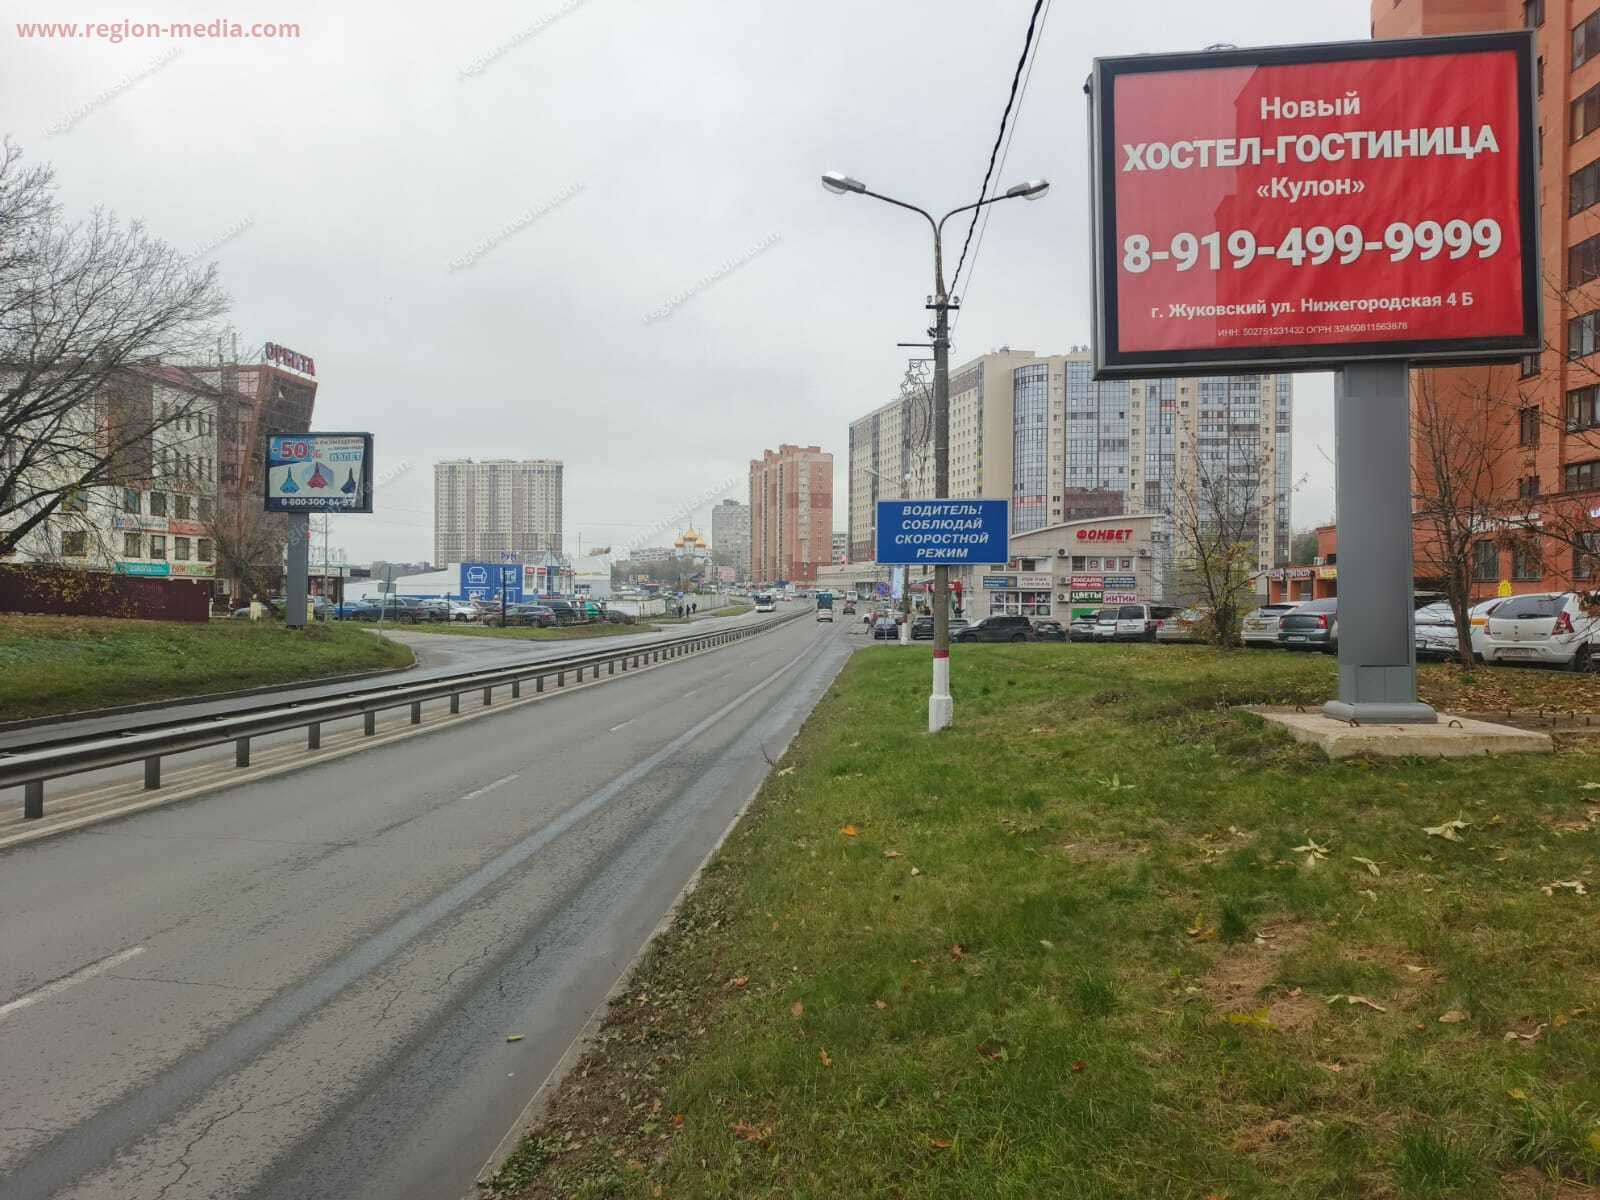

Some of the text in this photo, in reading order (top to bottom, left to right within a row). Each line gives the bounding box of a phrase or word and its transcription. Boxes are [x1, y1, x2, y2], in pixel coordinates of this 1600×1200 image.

[1260, 90, 1360, 120] Новый
[1122, 124, 1499, 172] ХОСТЕЛ-ГОСТИНИЦА
[1256, 176, 1365, 203] «Кулон»
[1123, 218, 1502, 273] 8-919-499-9999
[1151, 292, 1474, 319] г. Жуковский ул. Нижегородская 4 Б
[902, 505, 983, 517] ВОДИТЕЛЬ!
[902, 517, 983, 530] СОБЛЮДАЙ
[895, 531, 989, 545] СКОРОСТНОЙ
[1076, 528, 1133, 540] ФОНБЕТ
[916, 547, 969, 559] РЕЖИМ
